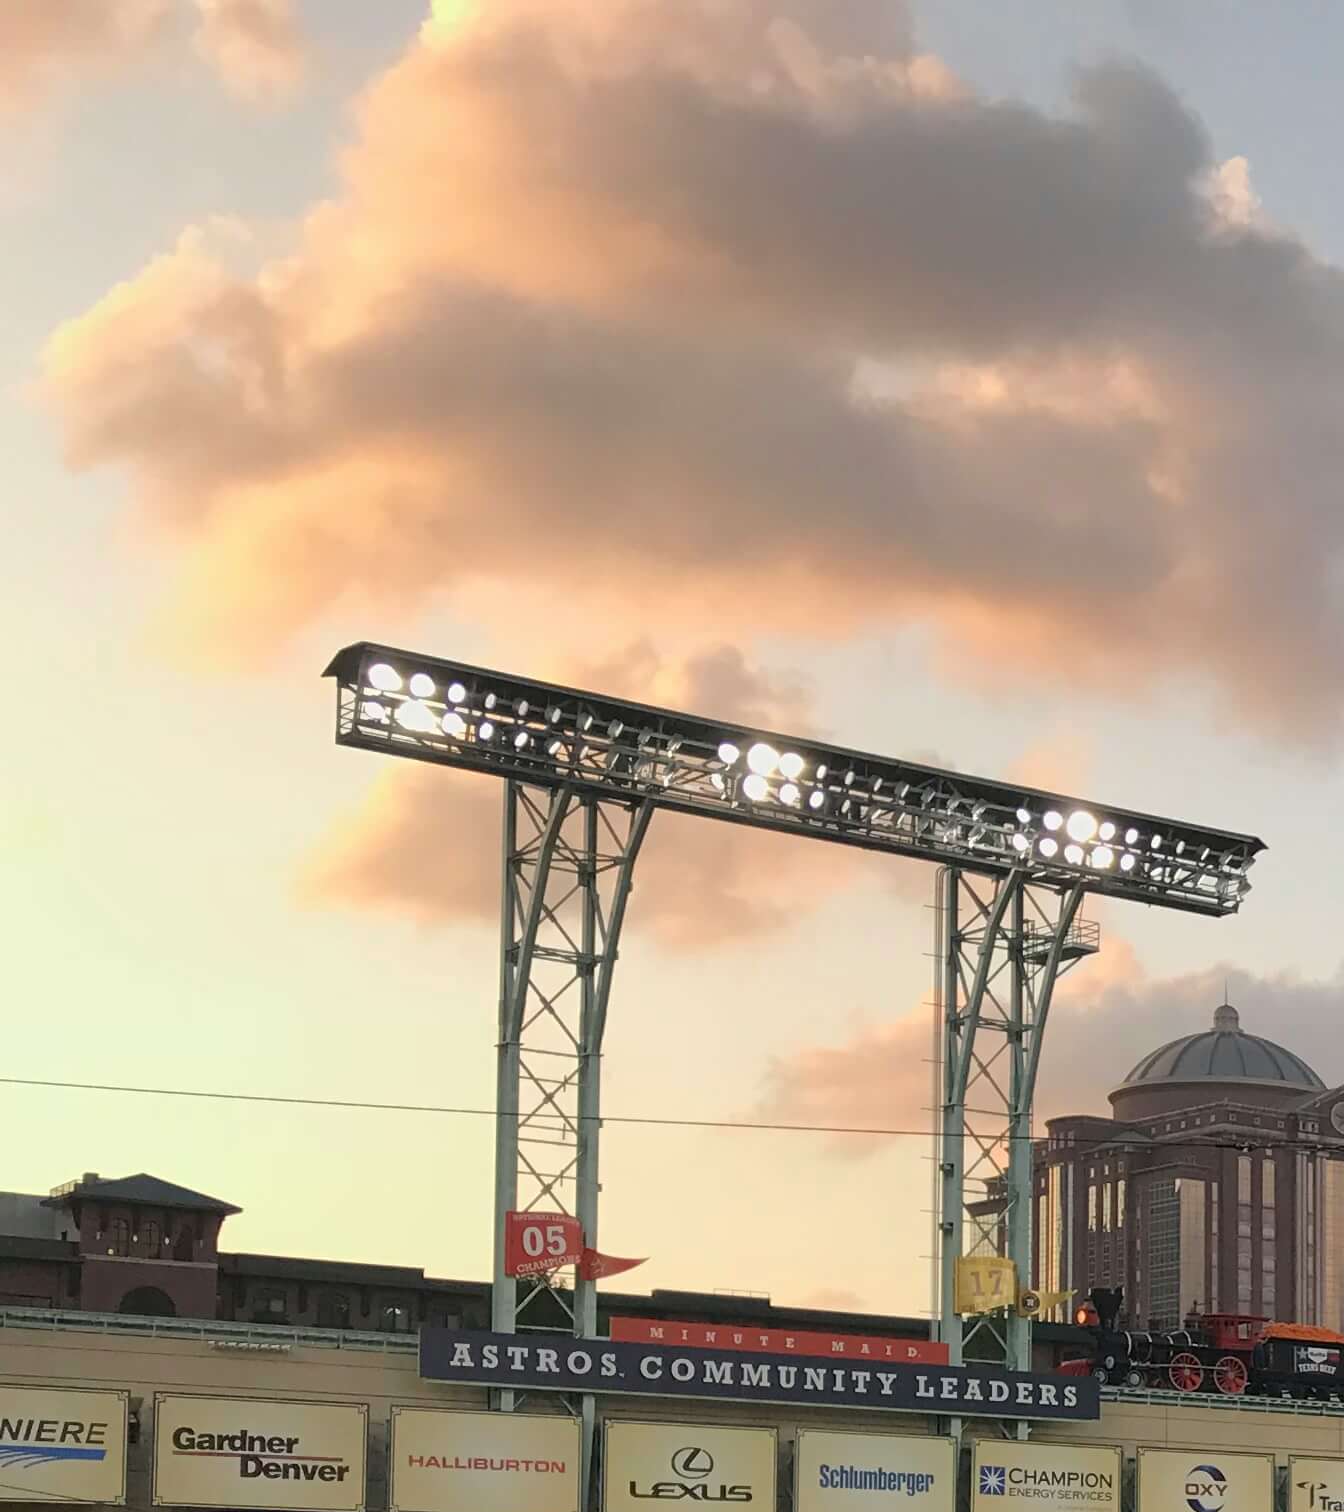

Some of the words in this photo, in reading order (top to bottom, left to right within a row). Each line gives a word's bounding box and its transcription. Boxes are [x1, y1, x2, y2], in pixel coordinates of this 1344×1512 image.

[522, 1225, 568, 1258] 05
[650, 1326, 795, 1349] MINUTE
[831, 1340, 919, 1358] MAID
[449, 1342, 617, 1377] ASTROS
[639, 1356, 897, 1396] COMMUNITY
[916, 1374, 1078, 1408] LEADERS
[172, 1427, 299, 1454] Gardner
[239, 1456, 349, 1483] Denver
[408, 1454, 566, 1474] HALLIBURTON
[630, 1481, 753, 1502] LEXUS
[819, 1464, 934, 1497] Schlumberger
[1009, 1467, 1113, 1489] CHAMPION
[1185, 1483, 1228, 1496] OXY
[1008, 1488, 1057, 1500] ENERGY
[1057, 1488, 1113, 1502] SERVICES
